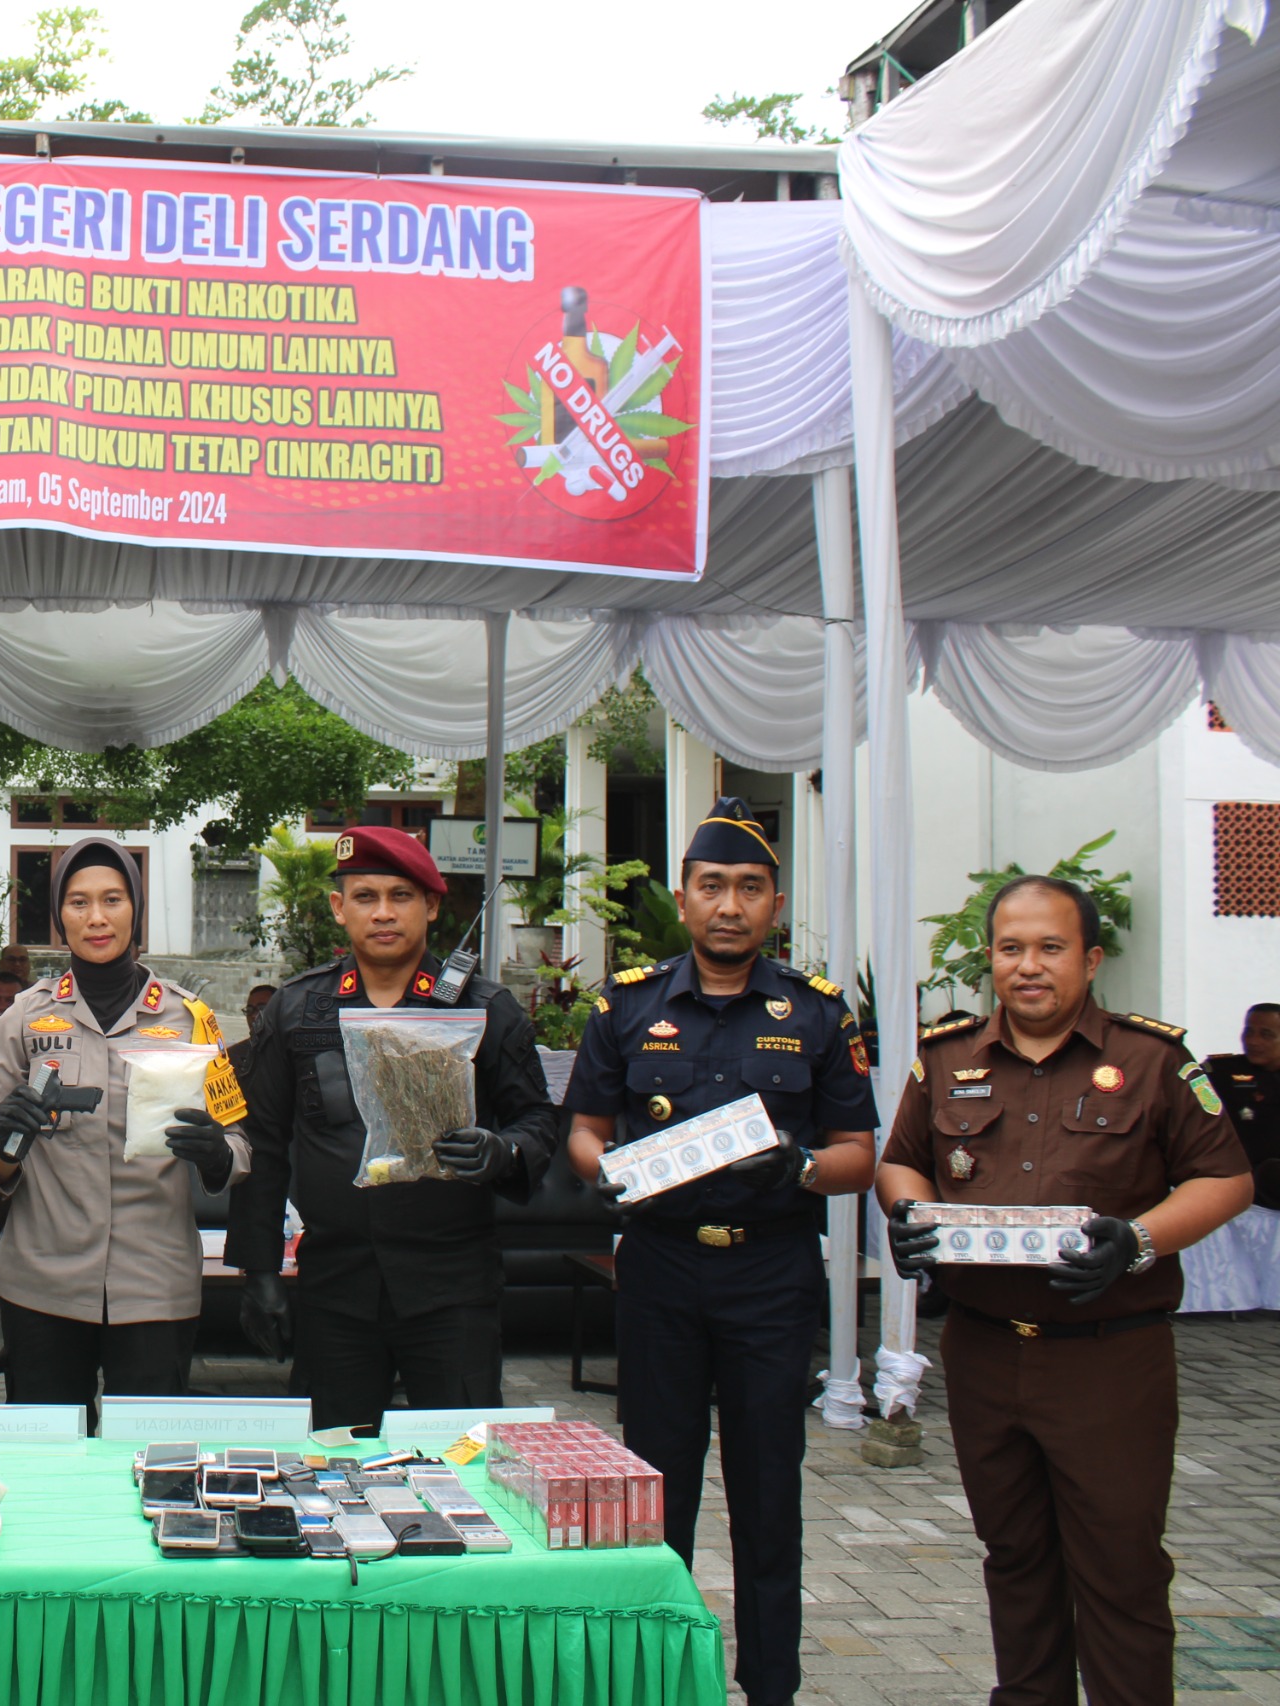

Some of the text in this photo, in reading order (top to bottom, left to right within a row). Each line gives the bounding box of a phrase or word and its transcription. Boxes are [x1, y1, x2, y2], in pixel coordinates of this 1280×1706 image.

[141, 189, 266, 267] DELI
[277, 195, 534, 281] SERDANG
[91, 274, 181, 316] BUKTI
[186, 278, 357, 324] NARKOTIKA
[56, 325, 164, 365] PIDANA
[169, 329, 269, 372] UMUM
[272, 334, 397, 377] LAINNYA
[74, 373, 185, 418] PIDANA
[189, 380, 313, 427] KHUSUS
[317, 386, 444, 431] LAINNYA
[533, 341, 644, 490] NO DRUGS
[57, 427, 165, 471] HUKUM
[170, 432, 261, 476] TETAP
[265, 438, 442, 484] (INKRACHT)
[39, 479, 62, 505] 05
[68, 479, 172, 522] September
[178, 491, 228, 524] 2024
[31, 1036, 72, 1053] JULI
[642, 1042, 680, 1051] ASRIZAL
[756, 1036, 802, 1045] CUSTOMS
[756, 1043, 802, 1053] EXCISE
